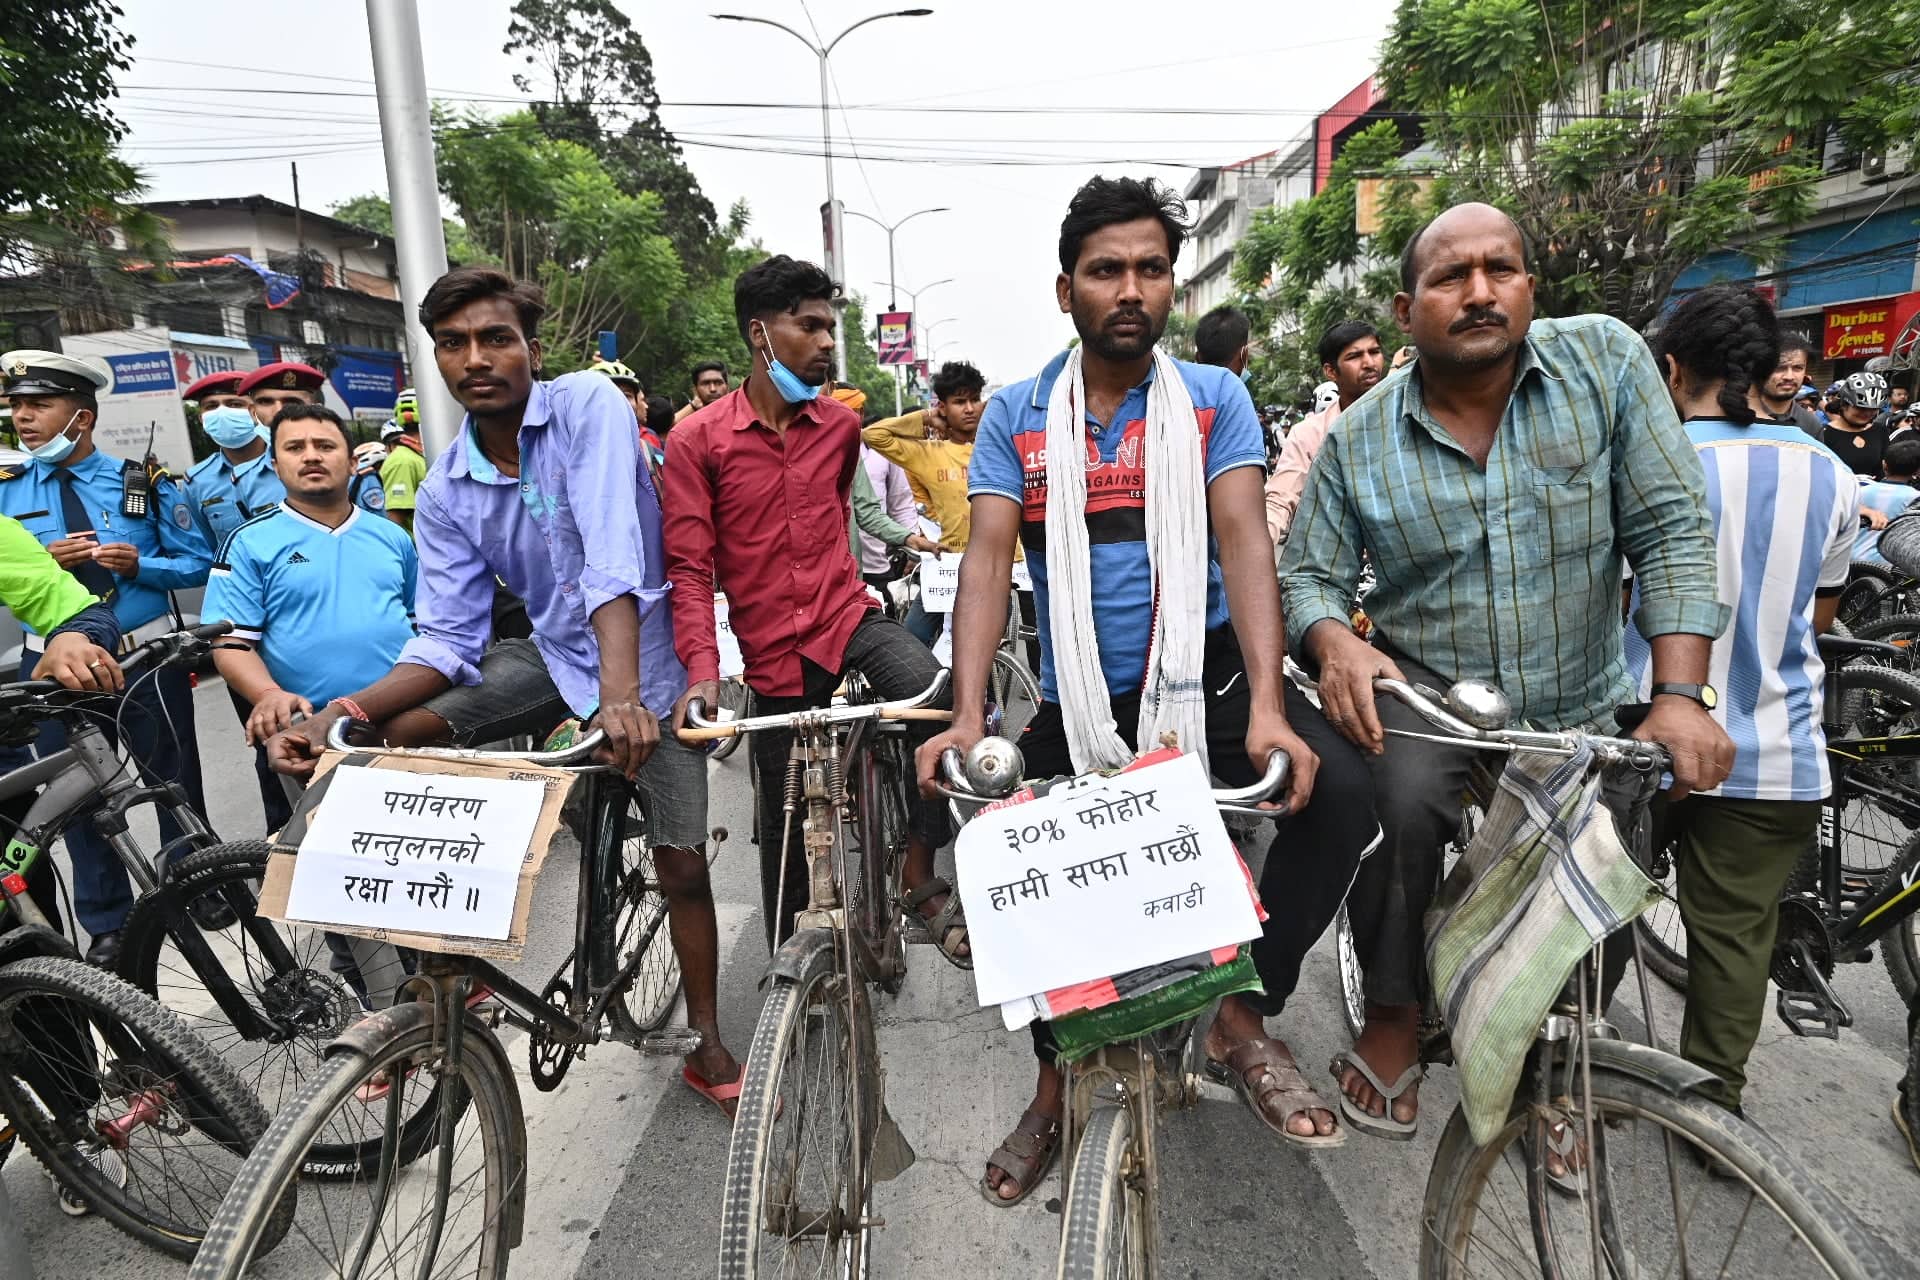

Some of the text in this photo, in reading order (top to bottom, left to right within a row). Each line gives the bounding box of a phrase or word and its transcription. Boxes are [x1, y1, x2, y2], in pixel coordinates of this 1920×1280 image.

[1829, 311, 1888, 328] Durbar
[1828, 330, 1885, 357] Jewels
[384, 786, 487, 820] पर्यावरण
[1076, 789, 1161, 830] फोहोर
[351, 832, 485, 866] सन्तुलनको
[344, 875, 394, 905] रक्षा
[407, 872, 454, 910] गरौं
[988, 868, 1049, 911] हामी
[1063, 852, 1129, 889] सफा
[1144, 882, 1205, 918] कवाडी
